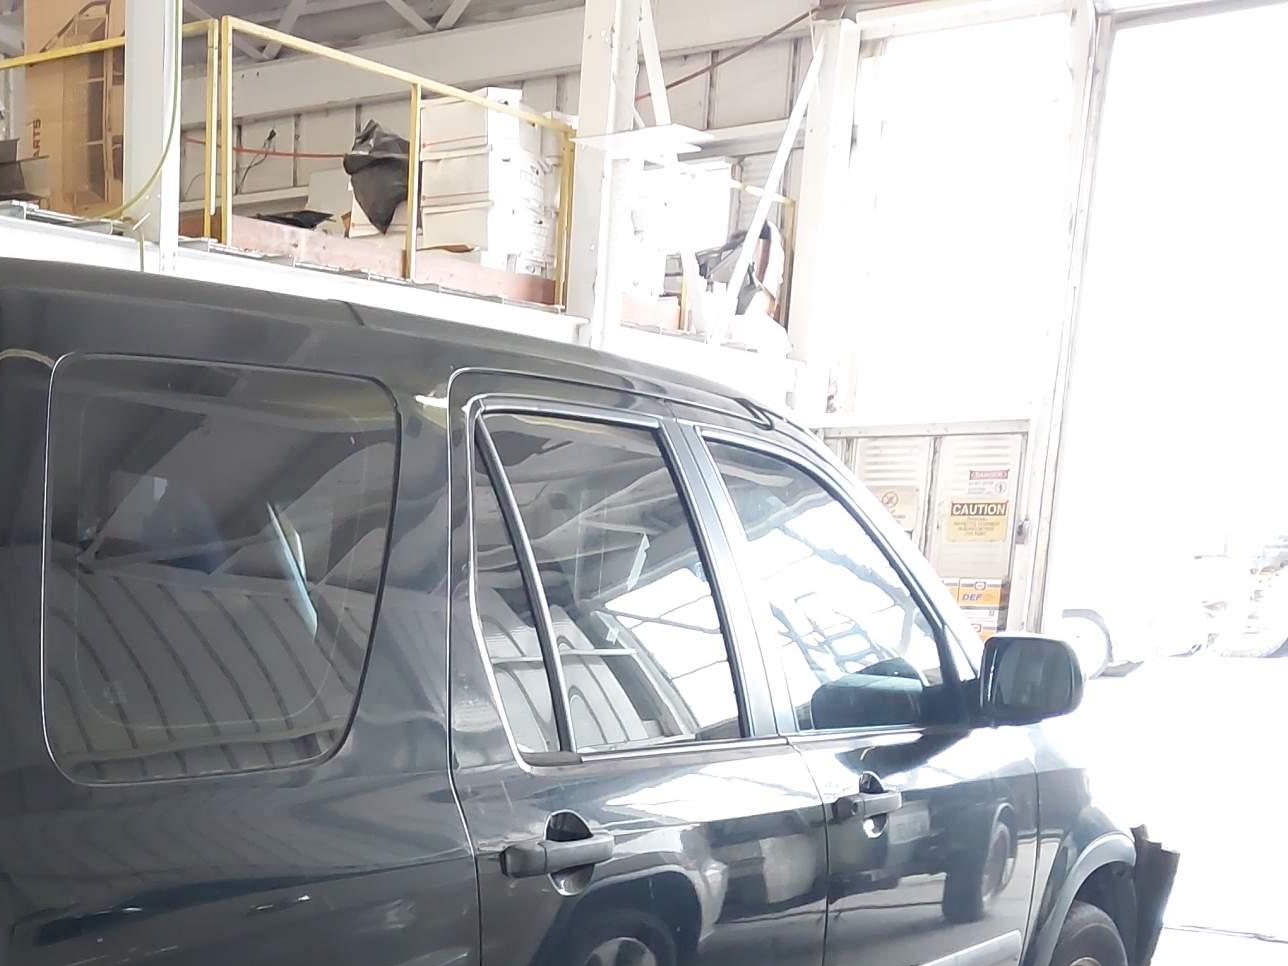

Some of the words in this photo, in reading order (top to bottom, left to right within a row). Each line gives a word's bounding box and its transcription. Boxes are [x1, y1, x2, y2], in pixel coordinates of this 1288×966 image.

[33, 118, 41, 159] ARTS
[953, 504, 1005, 515] CAUTION
[962, 593, 982, 601] DEF
